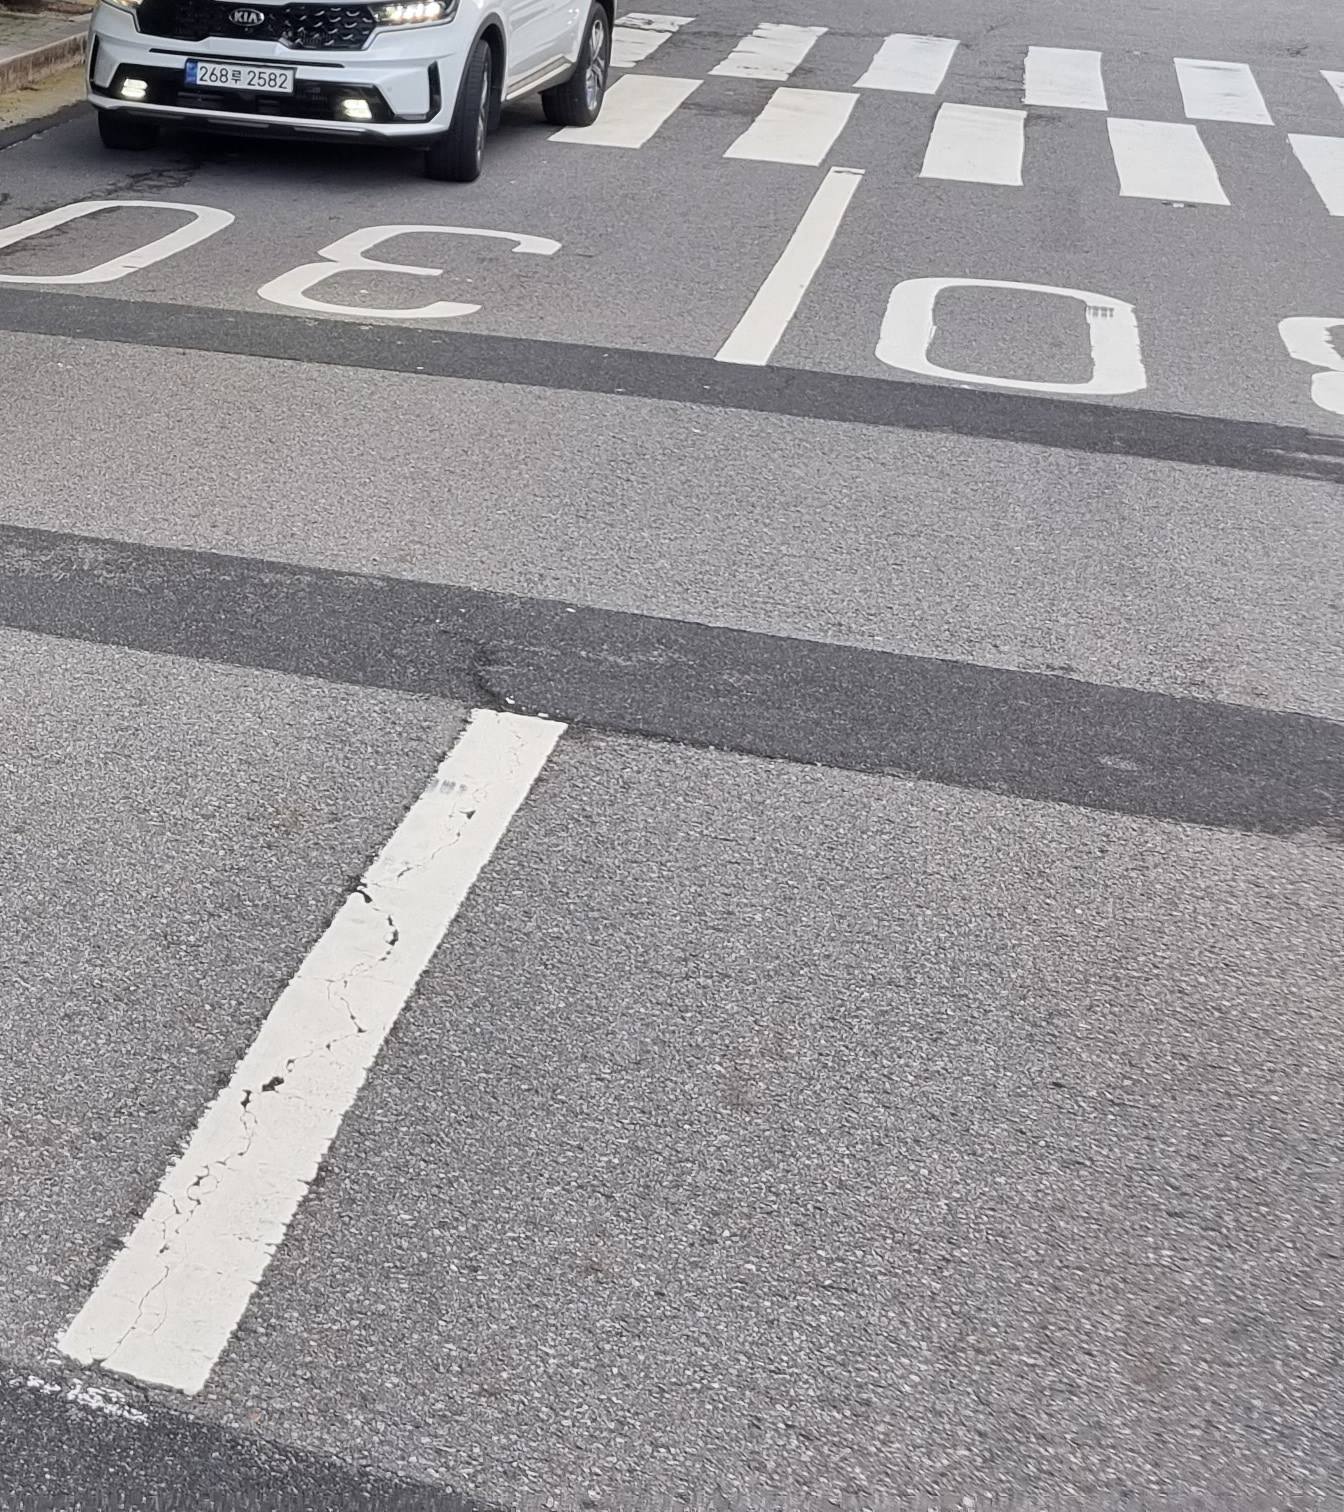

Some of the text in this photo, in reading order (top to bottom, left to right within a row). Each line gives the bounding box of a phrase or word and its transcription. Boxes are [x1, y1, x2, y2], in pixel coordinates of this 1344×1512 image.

[232, 10, 261, 24] KIA
[198, 65, 289, 90] 268루 2582
